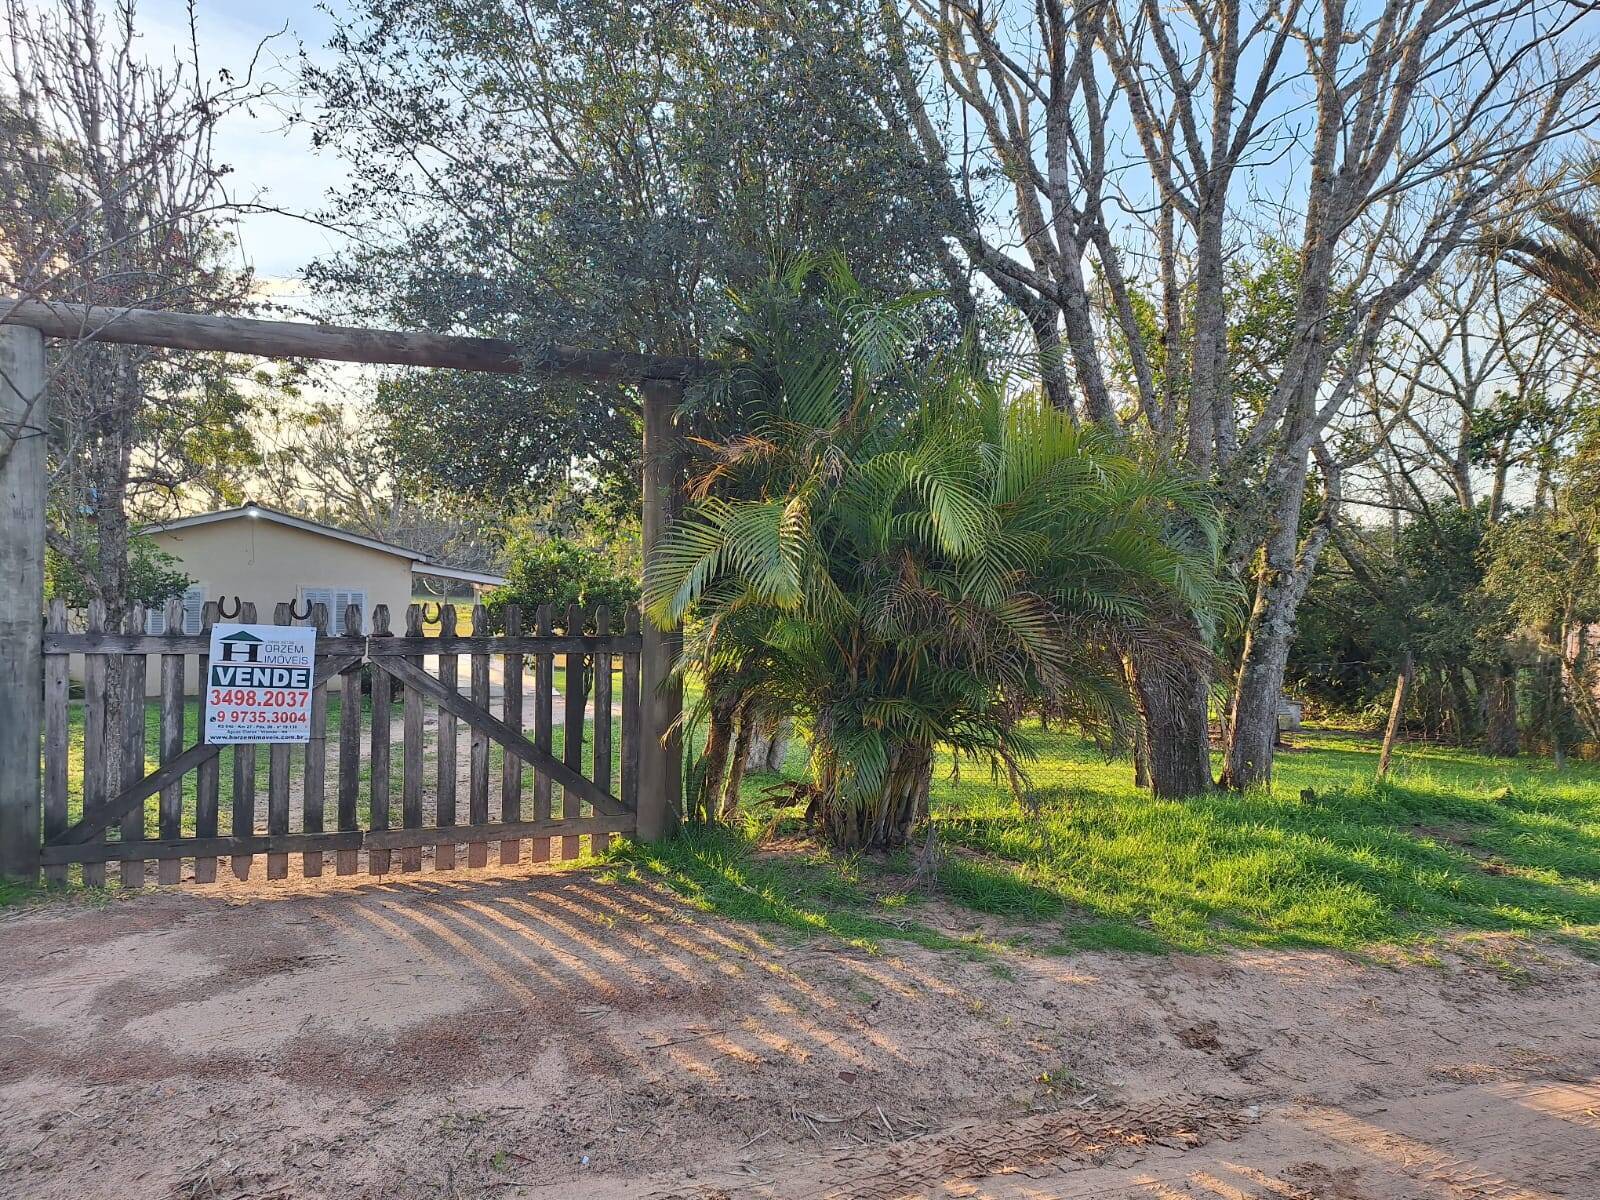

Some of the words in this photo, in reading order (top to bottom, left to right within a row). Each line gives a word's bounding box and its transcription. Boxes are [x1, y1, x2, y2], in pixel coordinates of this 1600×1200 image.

[265, 644, 304, 654] ORZEM
[264, 654, 309, 665] IMÓVEIS
[216, 667, 307, 688] VENDE
[210, 689, 309, 708] 3498.2037
[217, 711, 226, 723] 9
[230, 711, 307, 724] 9735.3004
